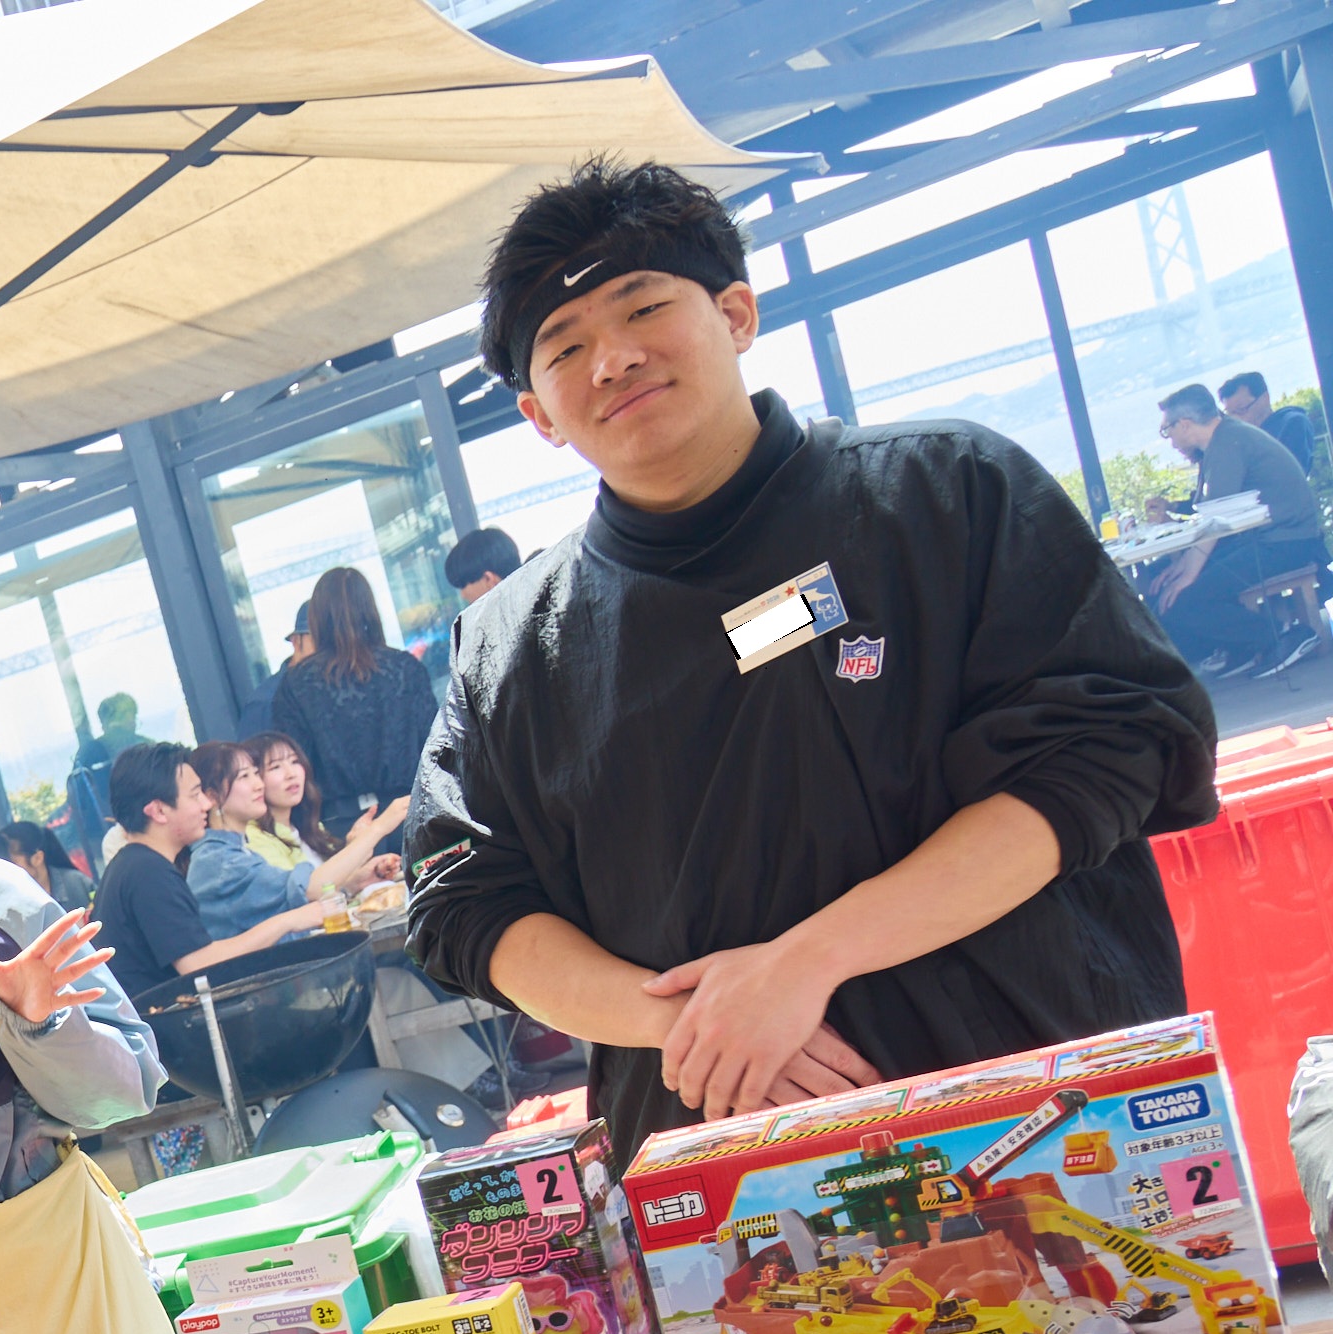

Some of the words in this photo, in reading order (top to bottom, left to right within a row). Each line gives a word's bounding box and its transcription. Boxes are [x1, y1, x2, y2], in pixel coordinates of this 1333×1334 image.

[841, 657, 877, 676] NFL
[1134, 1089, 1201, 1112] TAKARA
[1137, 1101, 1202, 1125] TOMY
[1128, 1127, 1222, 1156] 対象年齢3才以上
[536, 1168, 564, 1204] 2
[1185, 1165, 1219, 1206] 2
[642, 1191, 706, 1226] トミカ
[461, 1241, 580, 1284] フラワー
[228, 1266, 318, 1287] #CaptureYourMoment!
[256, 1310, 280, 1321] Includes
[282, 1307, 307, 1319] Lanyard
[316, 1306, 334, 1319] 3+
[182, 1317, 218, 1332] playpop
[420, 1324, 441, 1334] BOLT
